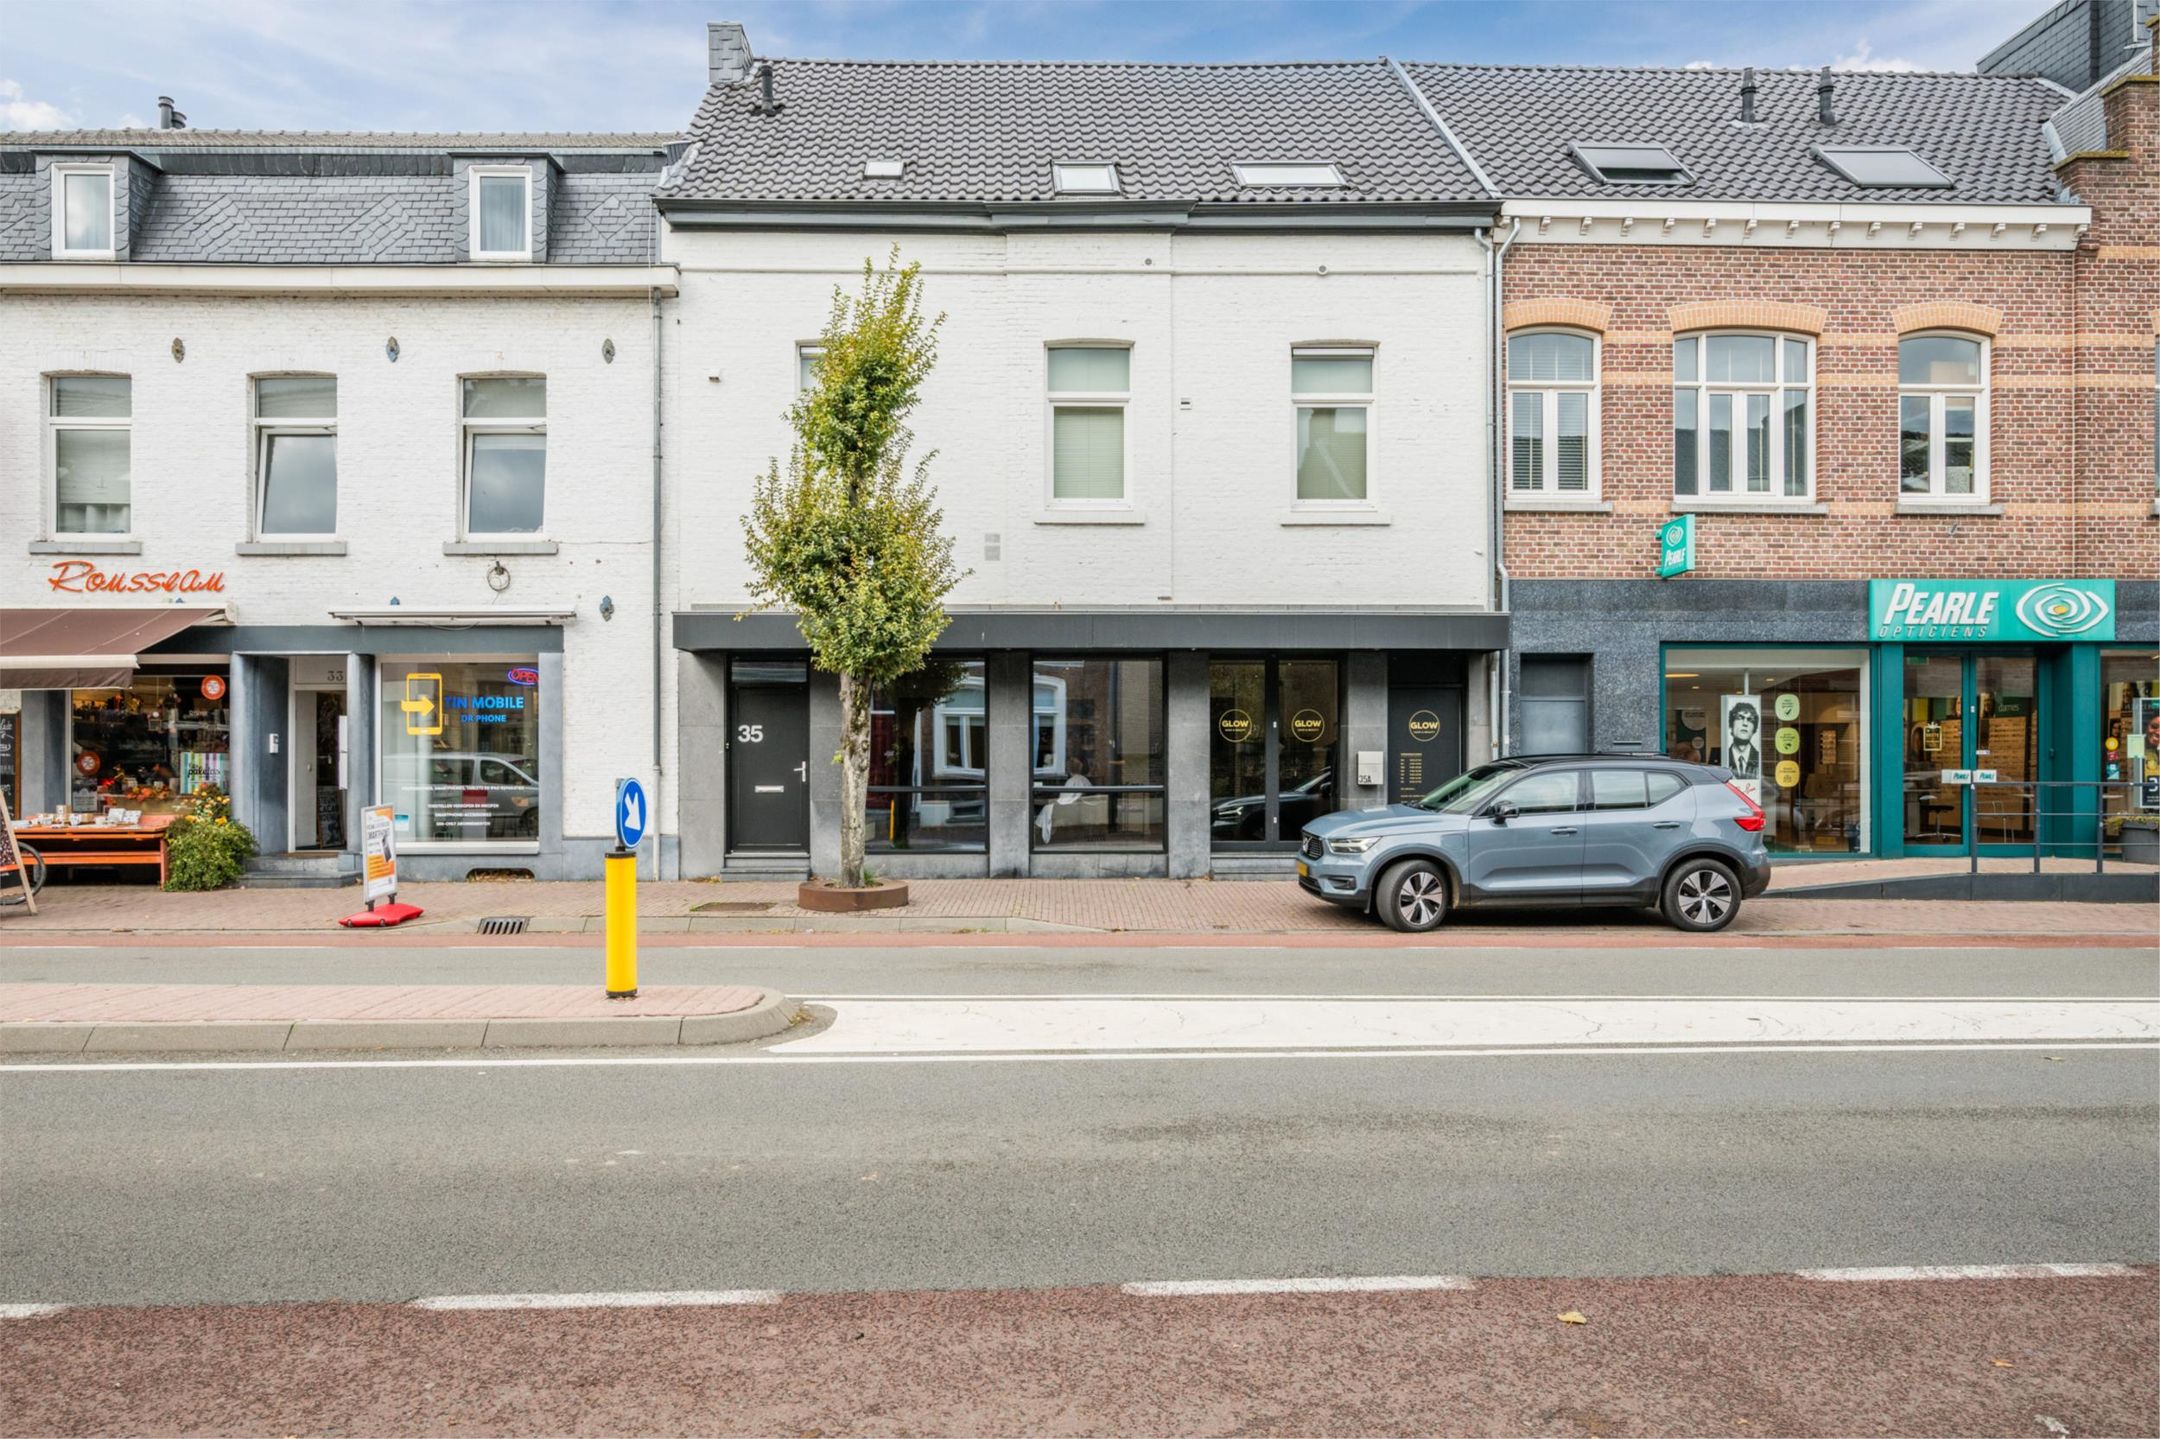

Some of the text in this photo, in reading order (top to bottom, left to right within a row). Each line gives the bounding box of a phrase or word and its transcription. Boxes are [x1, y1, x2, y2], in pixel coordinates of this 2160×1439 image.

[48, 560, 225, 592] Rousseau
[1882, 583, 1999, 625] PEARLE
[1878, 626, 1988, 638] OPTICIENS
[327, 671, 344, 682] 33
[445, 696, 525, 709] TIN MOBILE
[475, 714, 507, 723] PHONE
[1221, 720, 1249, 728] GLOW
[1294, 720, 1321, 728] GLOW
[1410, 722, 1439, 730] GLOW
[738, 725, 764, 742] 35
